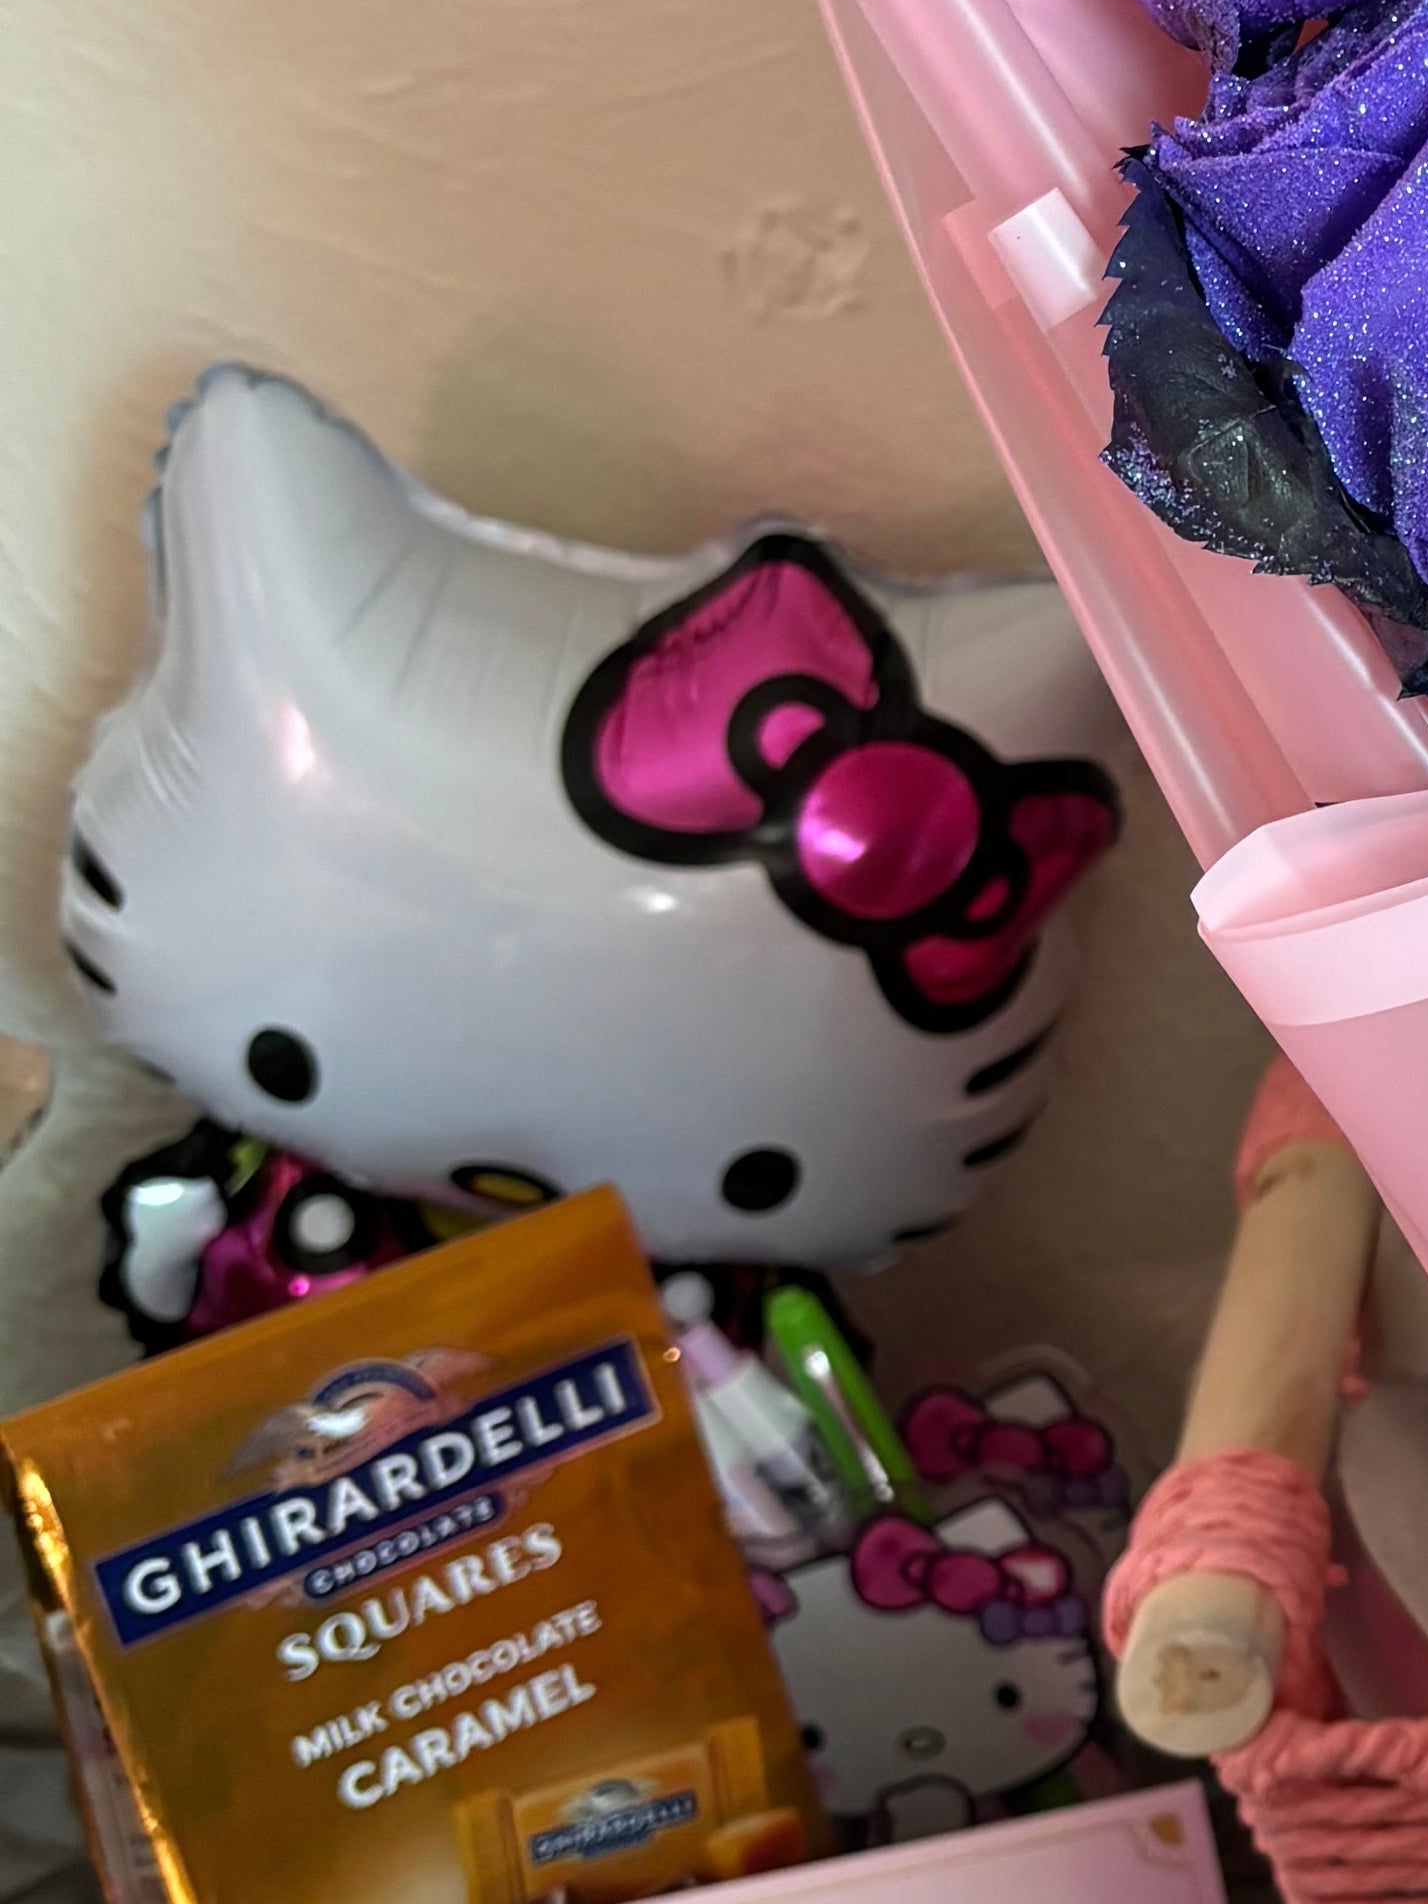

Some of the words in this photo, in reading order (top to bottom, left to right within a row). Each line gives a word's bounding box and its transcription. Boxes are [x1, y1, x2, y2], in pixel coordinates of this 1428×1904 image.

[123, 1362, 629, 1615] GHIRARDELLI
[309, 1495, 495, 1596] CHOCOLATE
[276, 1522, 563, 1682] SQUARES
[291, 1700, 388, 1769] MILK
[388, 1599, 602, 1720] CHOCOLATE
[336, 1662, 597, 1808] CARAMEL
